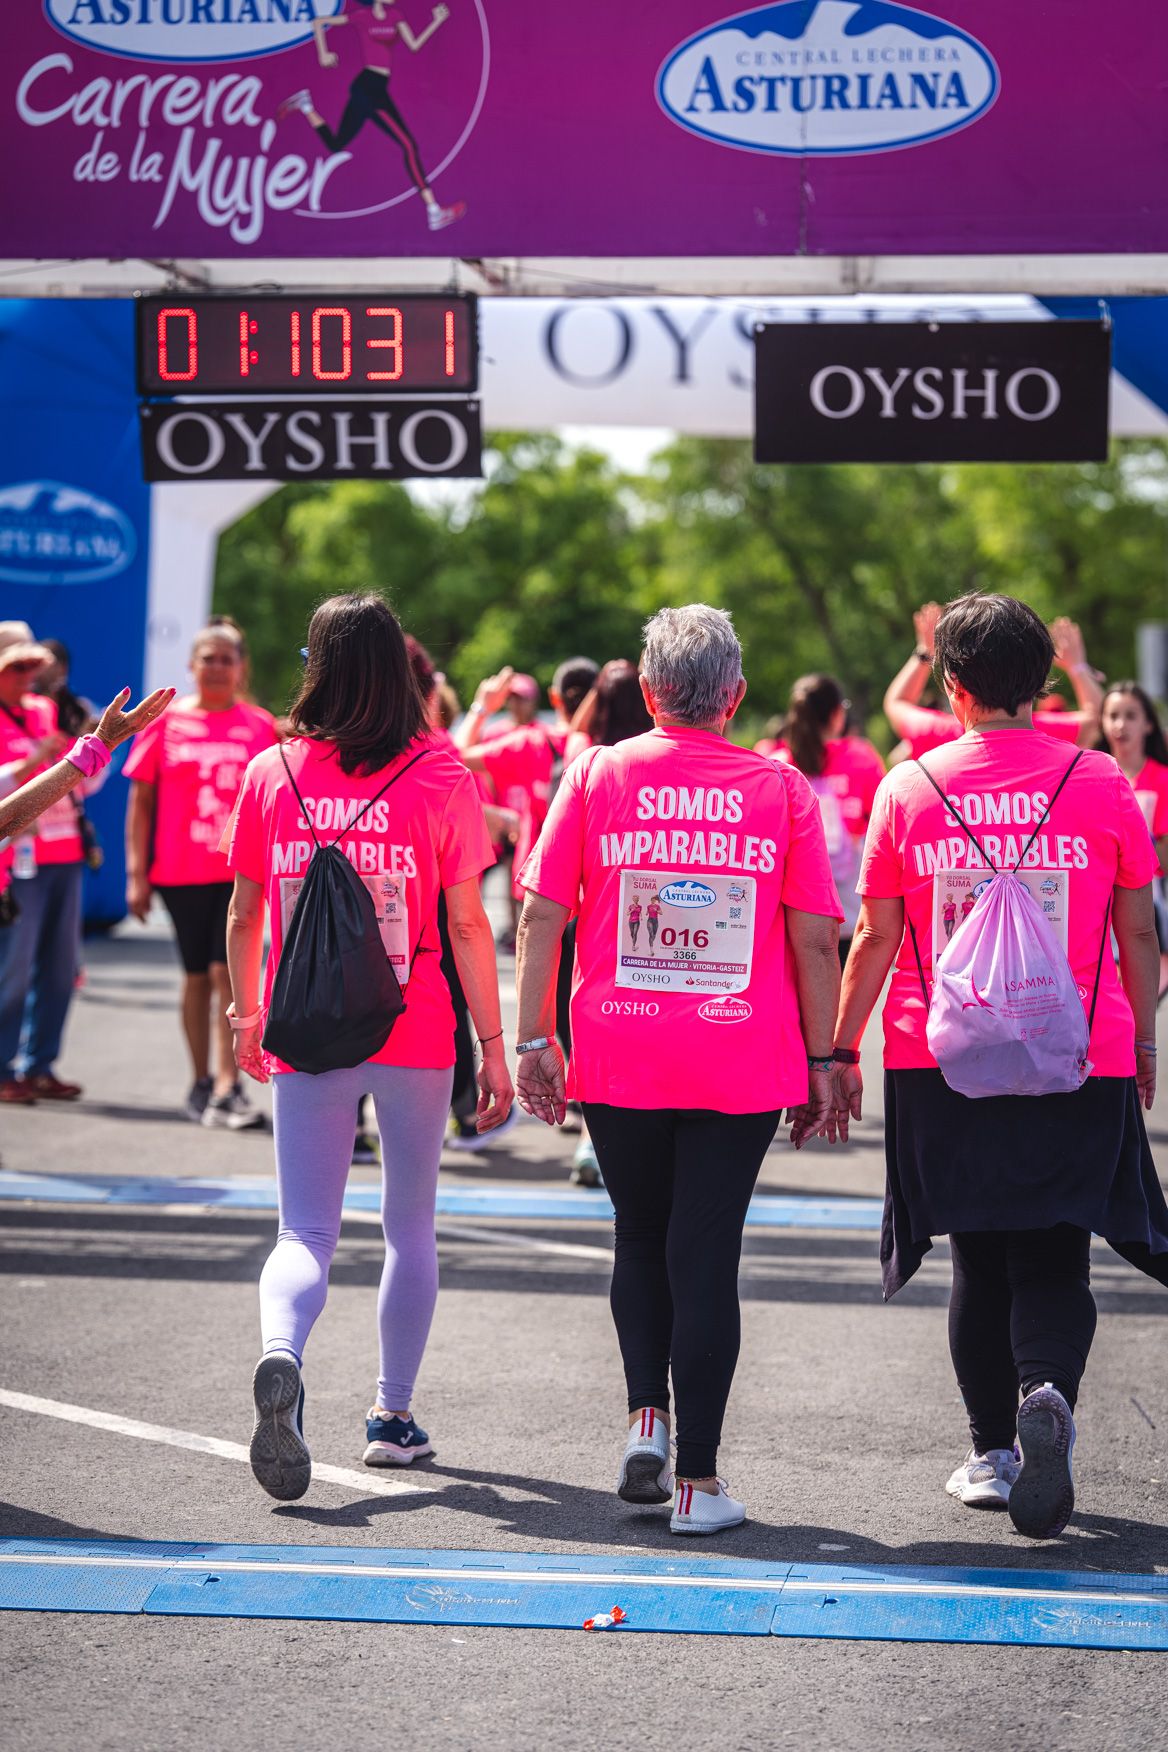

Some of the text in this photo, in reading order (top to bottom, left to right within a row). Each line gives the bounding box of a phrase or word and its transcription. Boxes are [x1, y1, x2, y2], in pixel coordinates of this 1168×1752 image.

[735, 46, 962, 66] CENTRAL LECHERA
[17, 53, 263, 128] Carrera
[684, 55, 971, 114] ASTURIANA
[74, 120, 352, 245] de la Mujer
[809, 364, 1062, 422] OYSHO
[156, 408, 469, 475] OYSHO
[297, 796, 390, 834] SOMOS
[636, 785, 744, 824] SOMOS
[944, 791, 1050, 828] SOMOS
[600, 830, 777, 874] IMPARABLES
[912, 833, 1090, 877] IMPARABLES
[633, 881, 658, 891] SUMA
[946, 880, 972, 888] SUMA
[663, 888, 712, 903] ASTURIANA
[661, 927, 709, 948] 016
[622, 958, 649, 967] CARRERA
[692, 963, 745, 972] VITORIA-GASTEIZ
[673, 950, 697, 960] 3366
[632, 972, 671, 985] OYSHO
[695, 978, 734, 988] Santander
[601, 1000, 660, 1016] OYSHO
[702, 1005, 749, 1017] ASTURIANA
